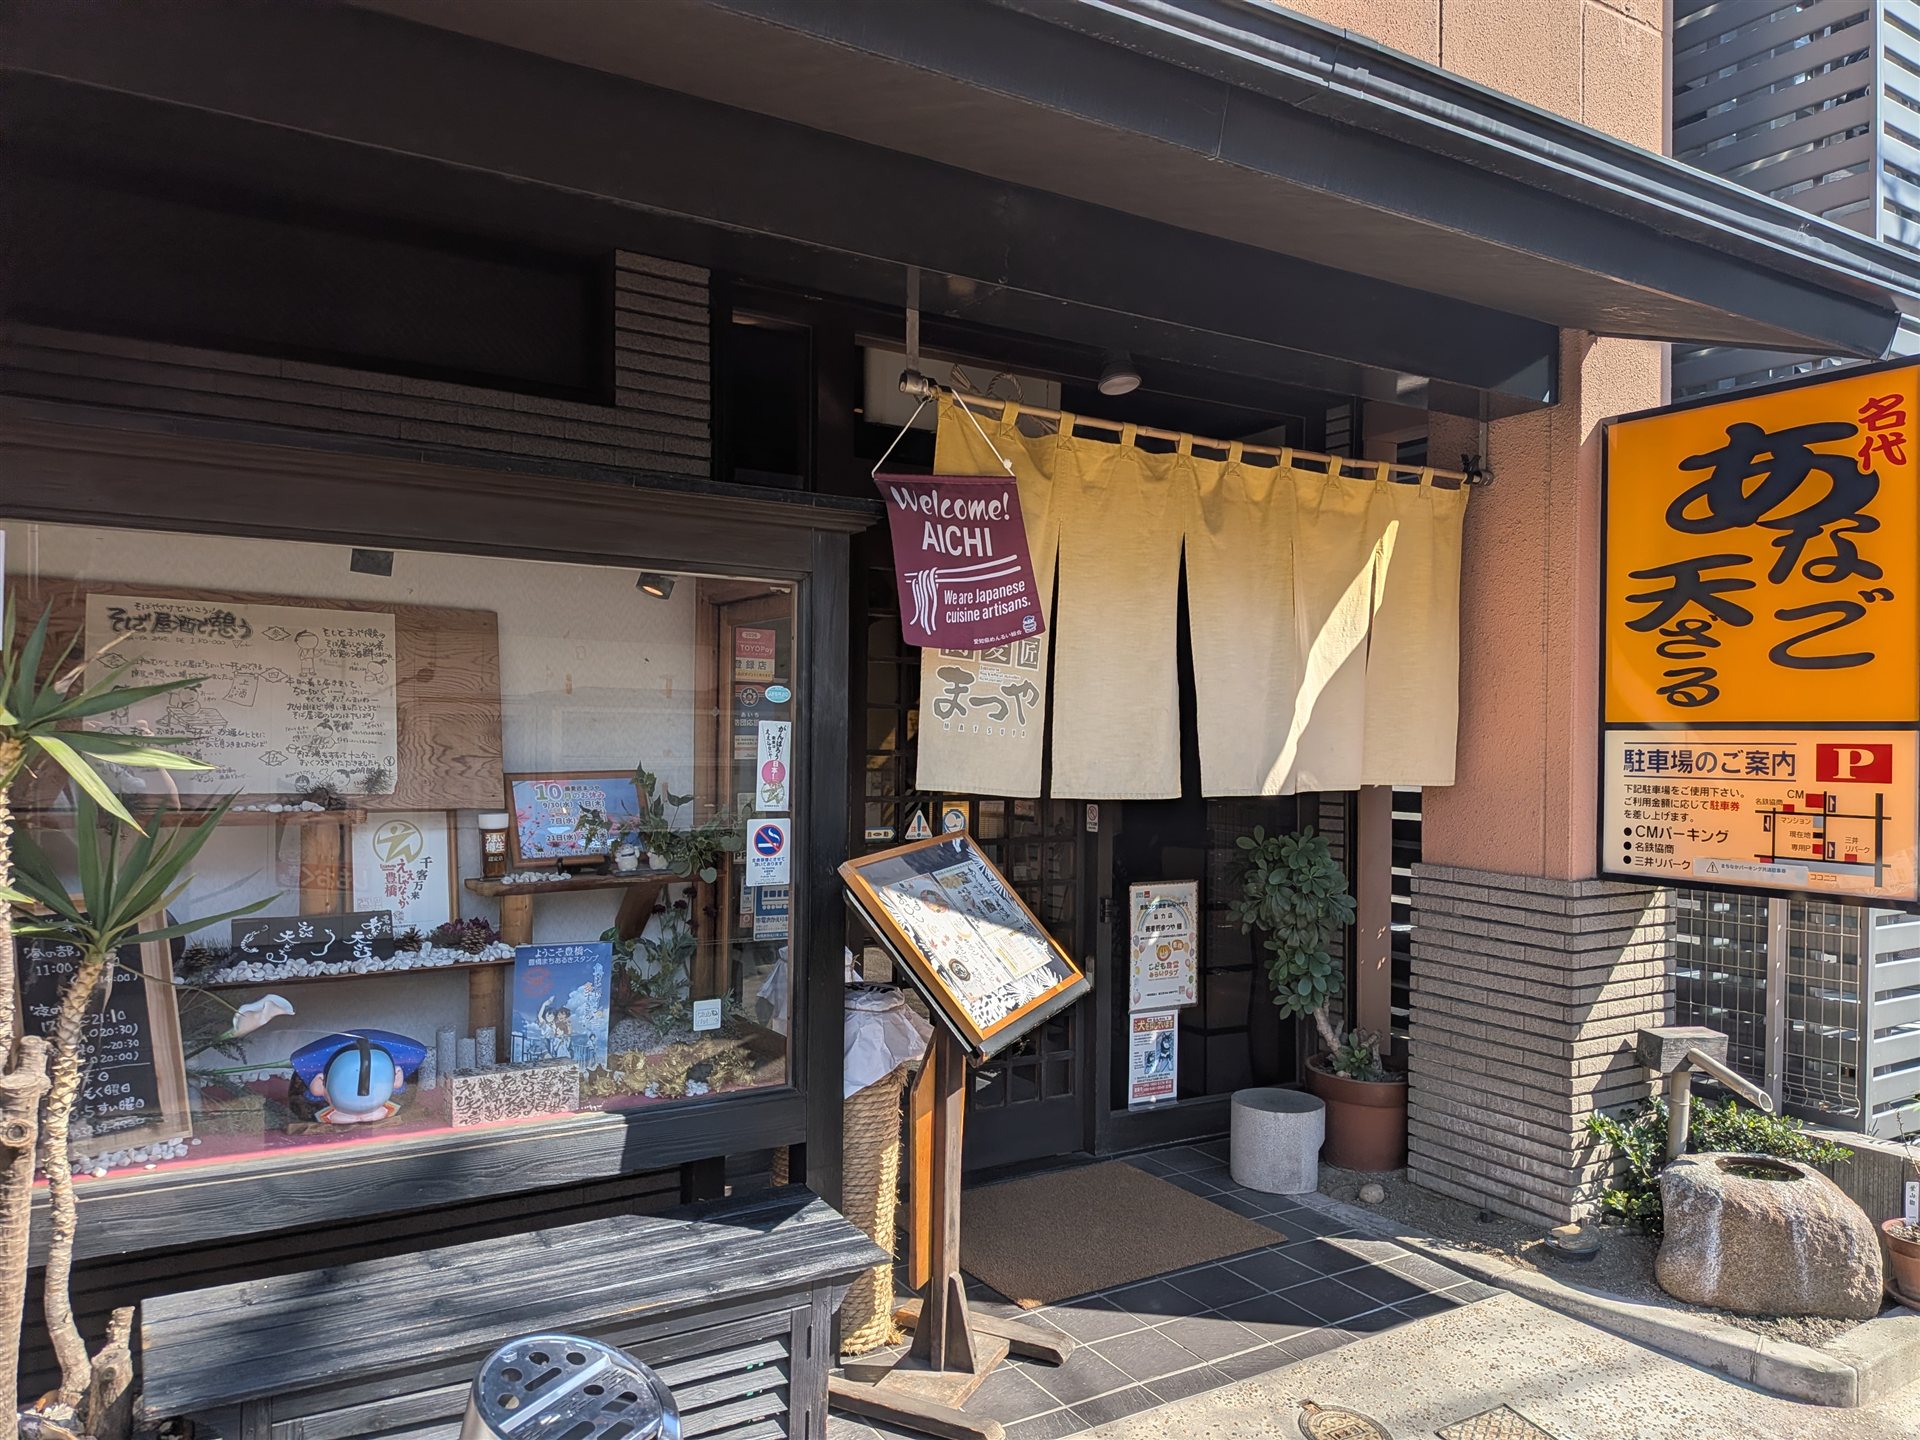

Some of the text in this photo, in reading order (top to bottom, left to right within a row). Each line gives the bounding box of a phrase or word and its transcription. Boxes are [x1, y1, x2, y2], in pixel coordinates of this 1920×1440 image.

[1858, 394, 1907, 470] 名代
[890, 486, 1010, 521] Welcome!
[922, 521, 993, 557] AICHI
[1665, 422, 1894, 669] あなご
[944, 580, 1025, 606] We are Japanese
[946, 597, 1031, 623] cuisine artisans.
[1625, 554, 1756, 707] 天ざる
[933, 665, 1041, 726] まつや
[1624, 748, 1874, 779] 駐車場のご案内 P
[535, 783, 562, 801] 10
[1624, 784, 1745, 798] 下記駐車場をご使用下さい。
[1624, 797, 1740, 811] ご利用金額に応じて駐車券
[1787, 790, 1804, 799] CM
[1624, 810, 1693, 823] を差し上げます。
[1781, 817, 1811, 825] マンション
[1635, 825, 1729, 843] CMパーキング
[1635, 842, 1675, 855] 名鉄協商
[385, 872, 398, 898] 豊橋
[411, 857, 432, 900] 千客万来
[535, 946, 593, 957] ようこそ豊橋へ
